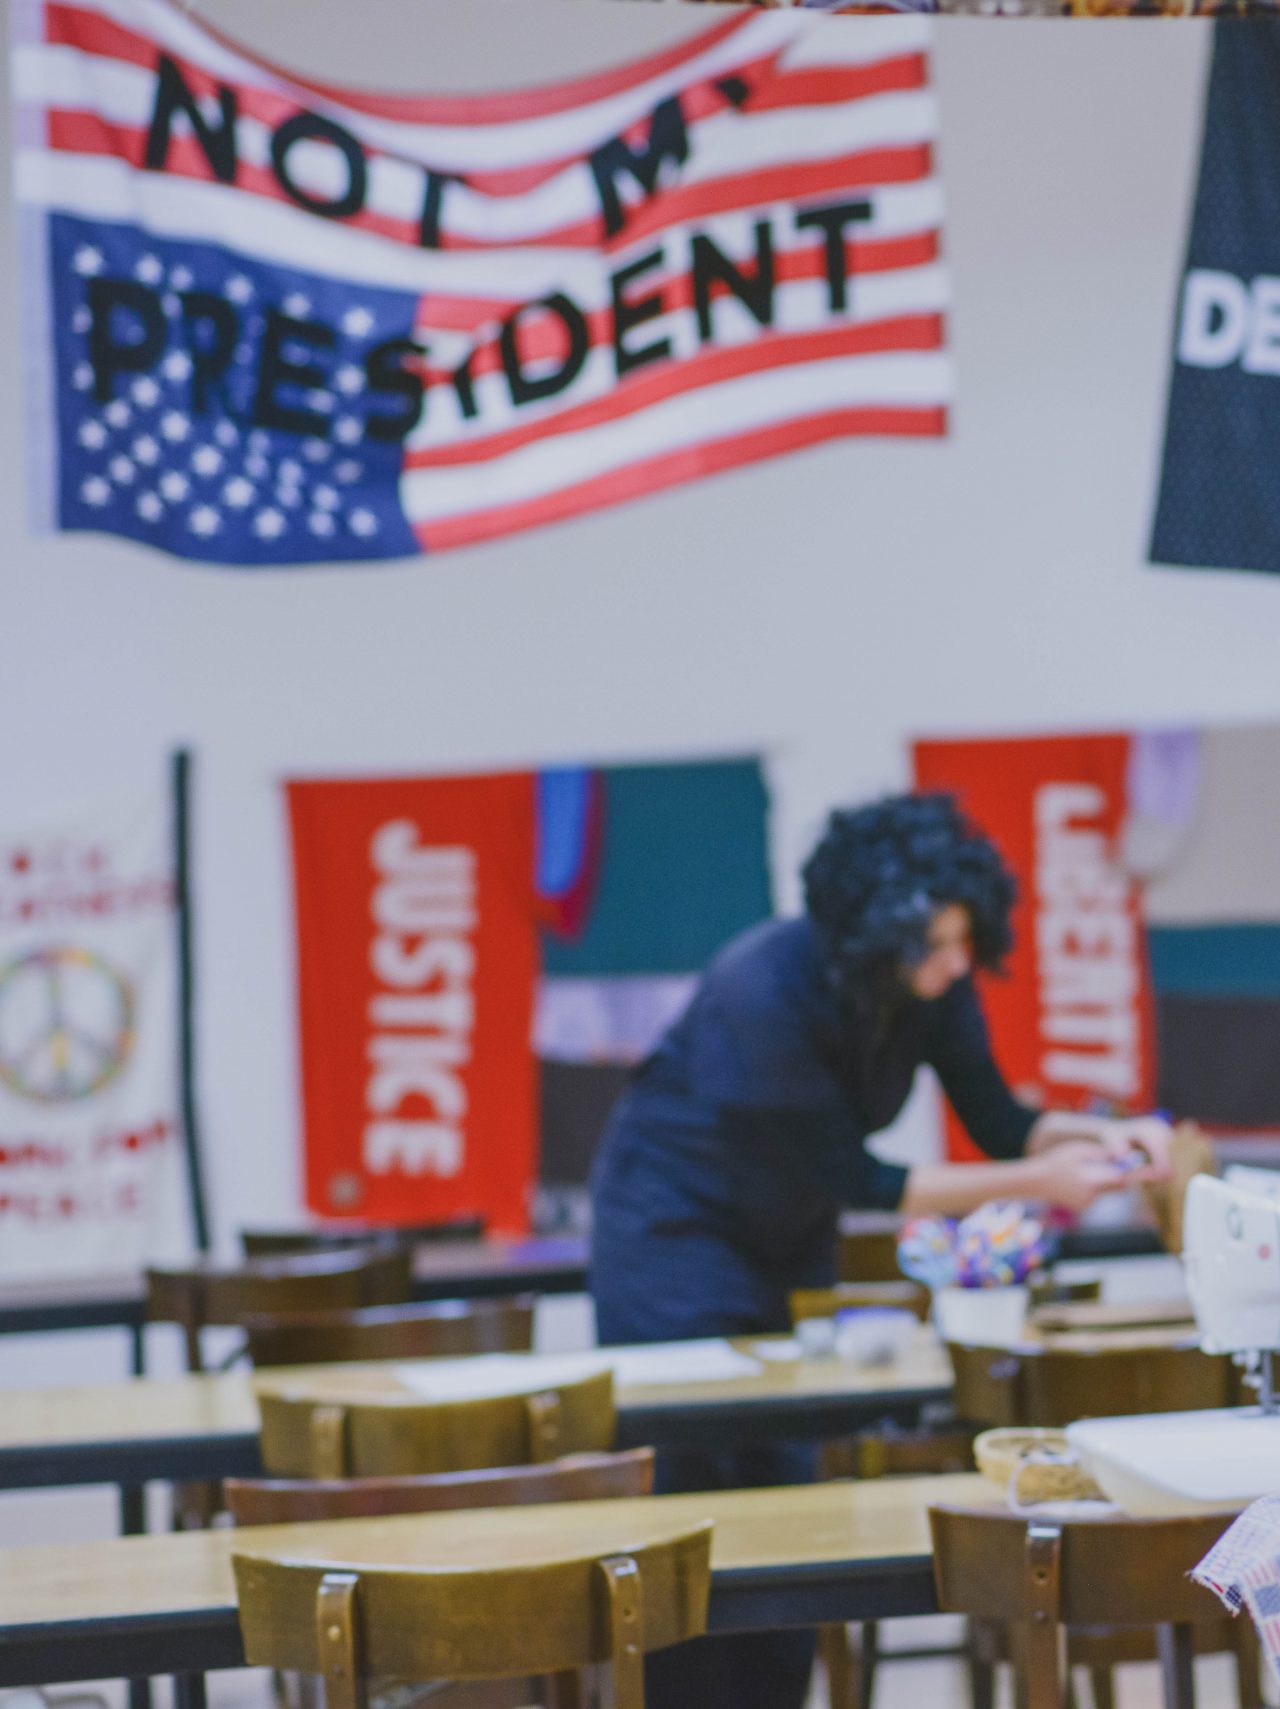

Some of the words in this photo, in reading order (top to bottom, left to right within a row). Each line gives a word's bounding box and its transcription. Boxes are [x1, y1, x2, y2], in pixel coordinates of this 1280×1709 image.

[144, 53, 468, 249] NOT
[86, 200, 873, 439] PRESIDENT
[362, 817, 477, 1178] JUSTICE
